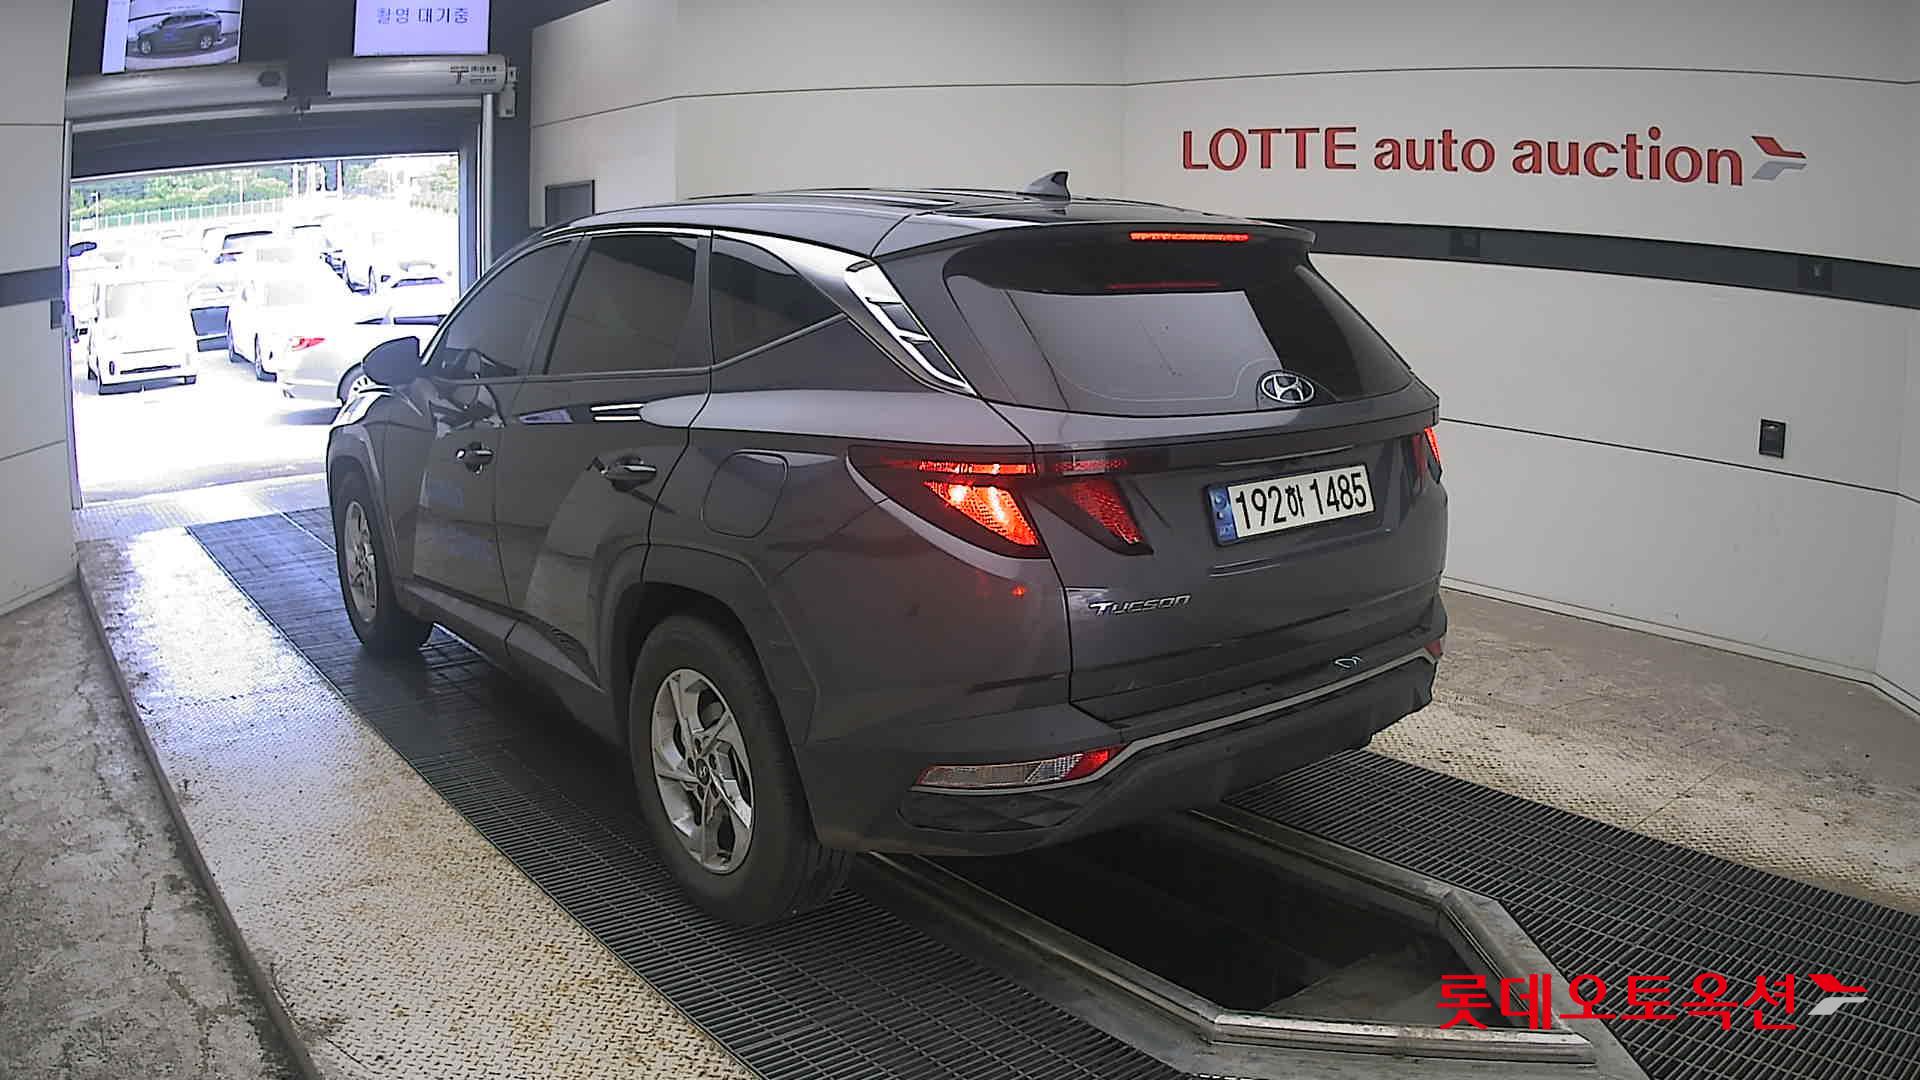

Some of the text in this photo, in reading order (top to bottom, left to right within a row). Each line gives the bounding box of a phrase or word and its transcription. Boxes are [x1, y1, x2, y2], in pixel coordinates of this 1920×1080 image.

[418, 7, 468, 25] 대기중
[1182, 126, 1744, 187] LOTTE auto auction
[1235, 471, 1367, 530] 192하 1485
